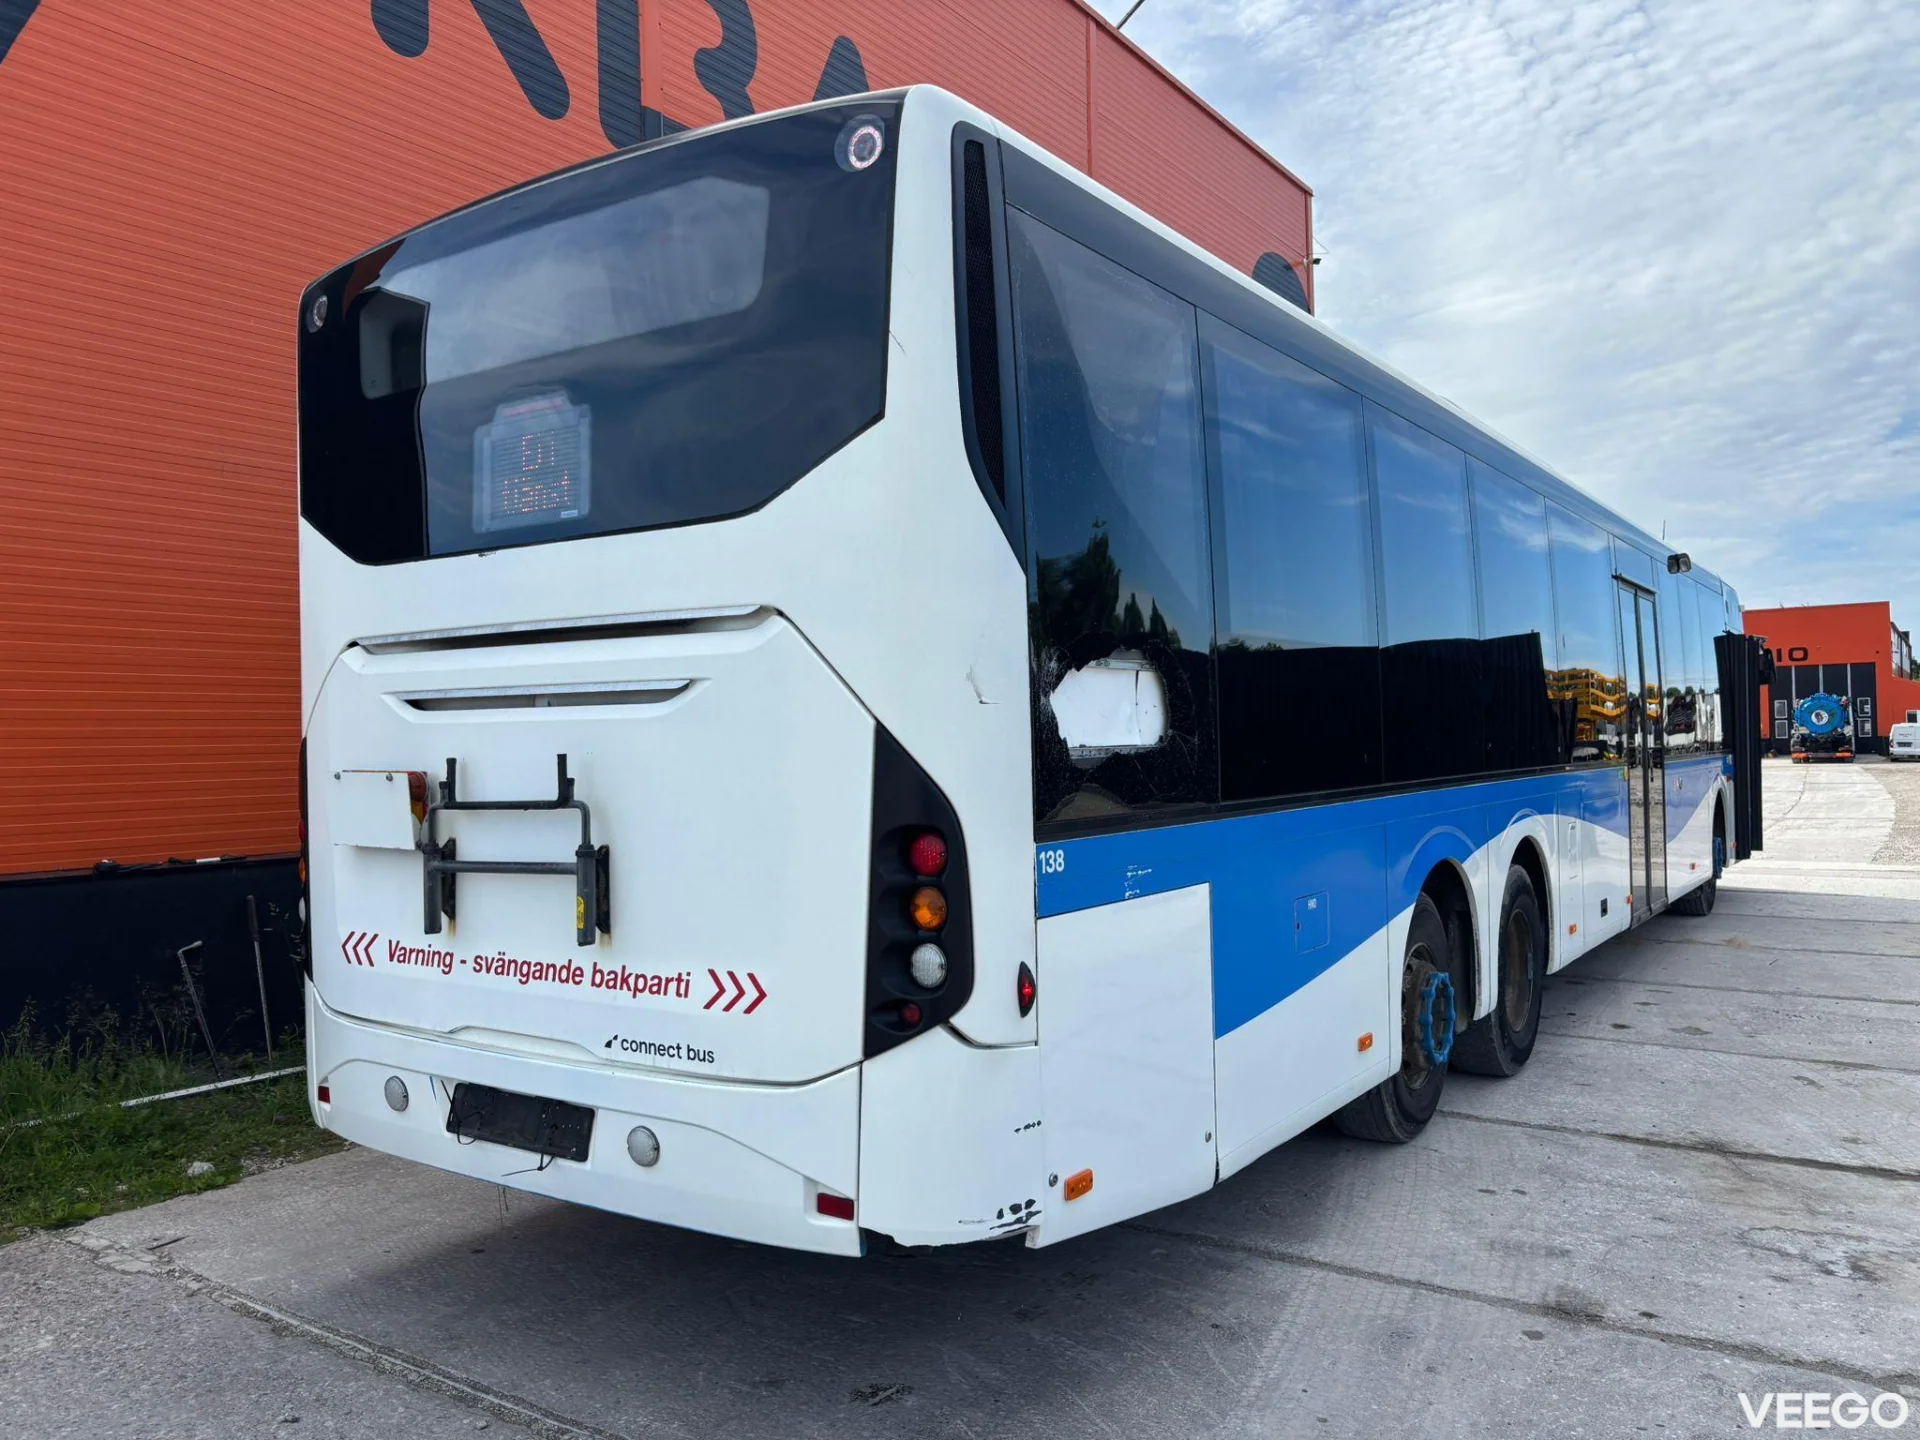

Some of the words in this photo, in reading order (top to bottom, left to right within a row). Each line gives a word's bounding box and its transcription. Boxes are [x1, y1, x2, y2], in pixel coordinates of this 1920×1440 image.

[1040, 849, 1064, 874] 138
[387, 939, 454, 975] Varning
[472, 950, 584, 986] svängande
[590, 962, 692, 999] bakparti
[620, 1038, 682, 1060] connect
[687, 1044, 715, 1063] bus
